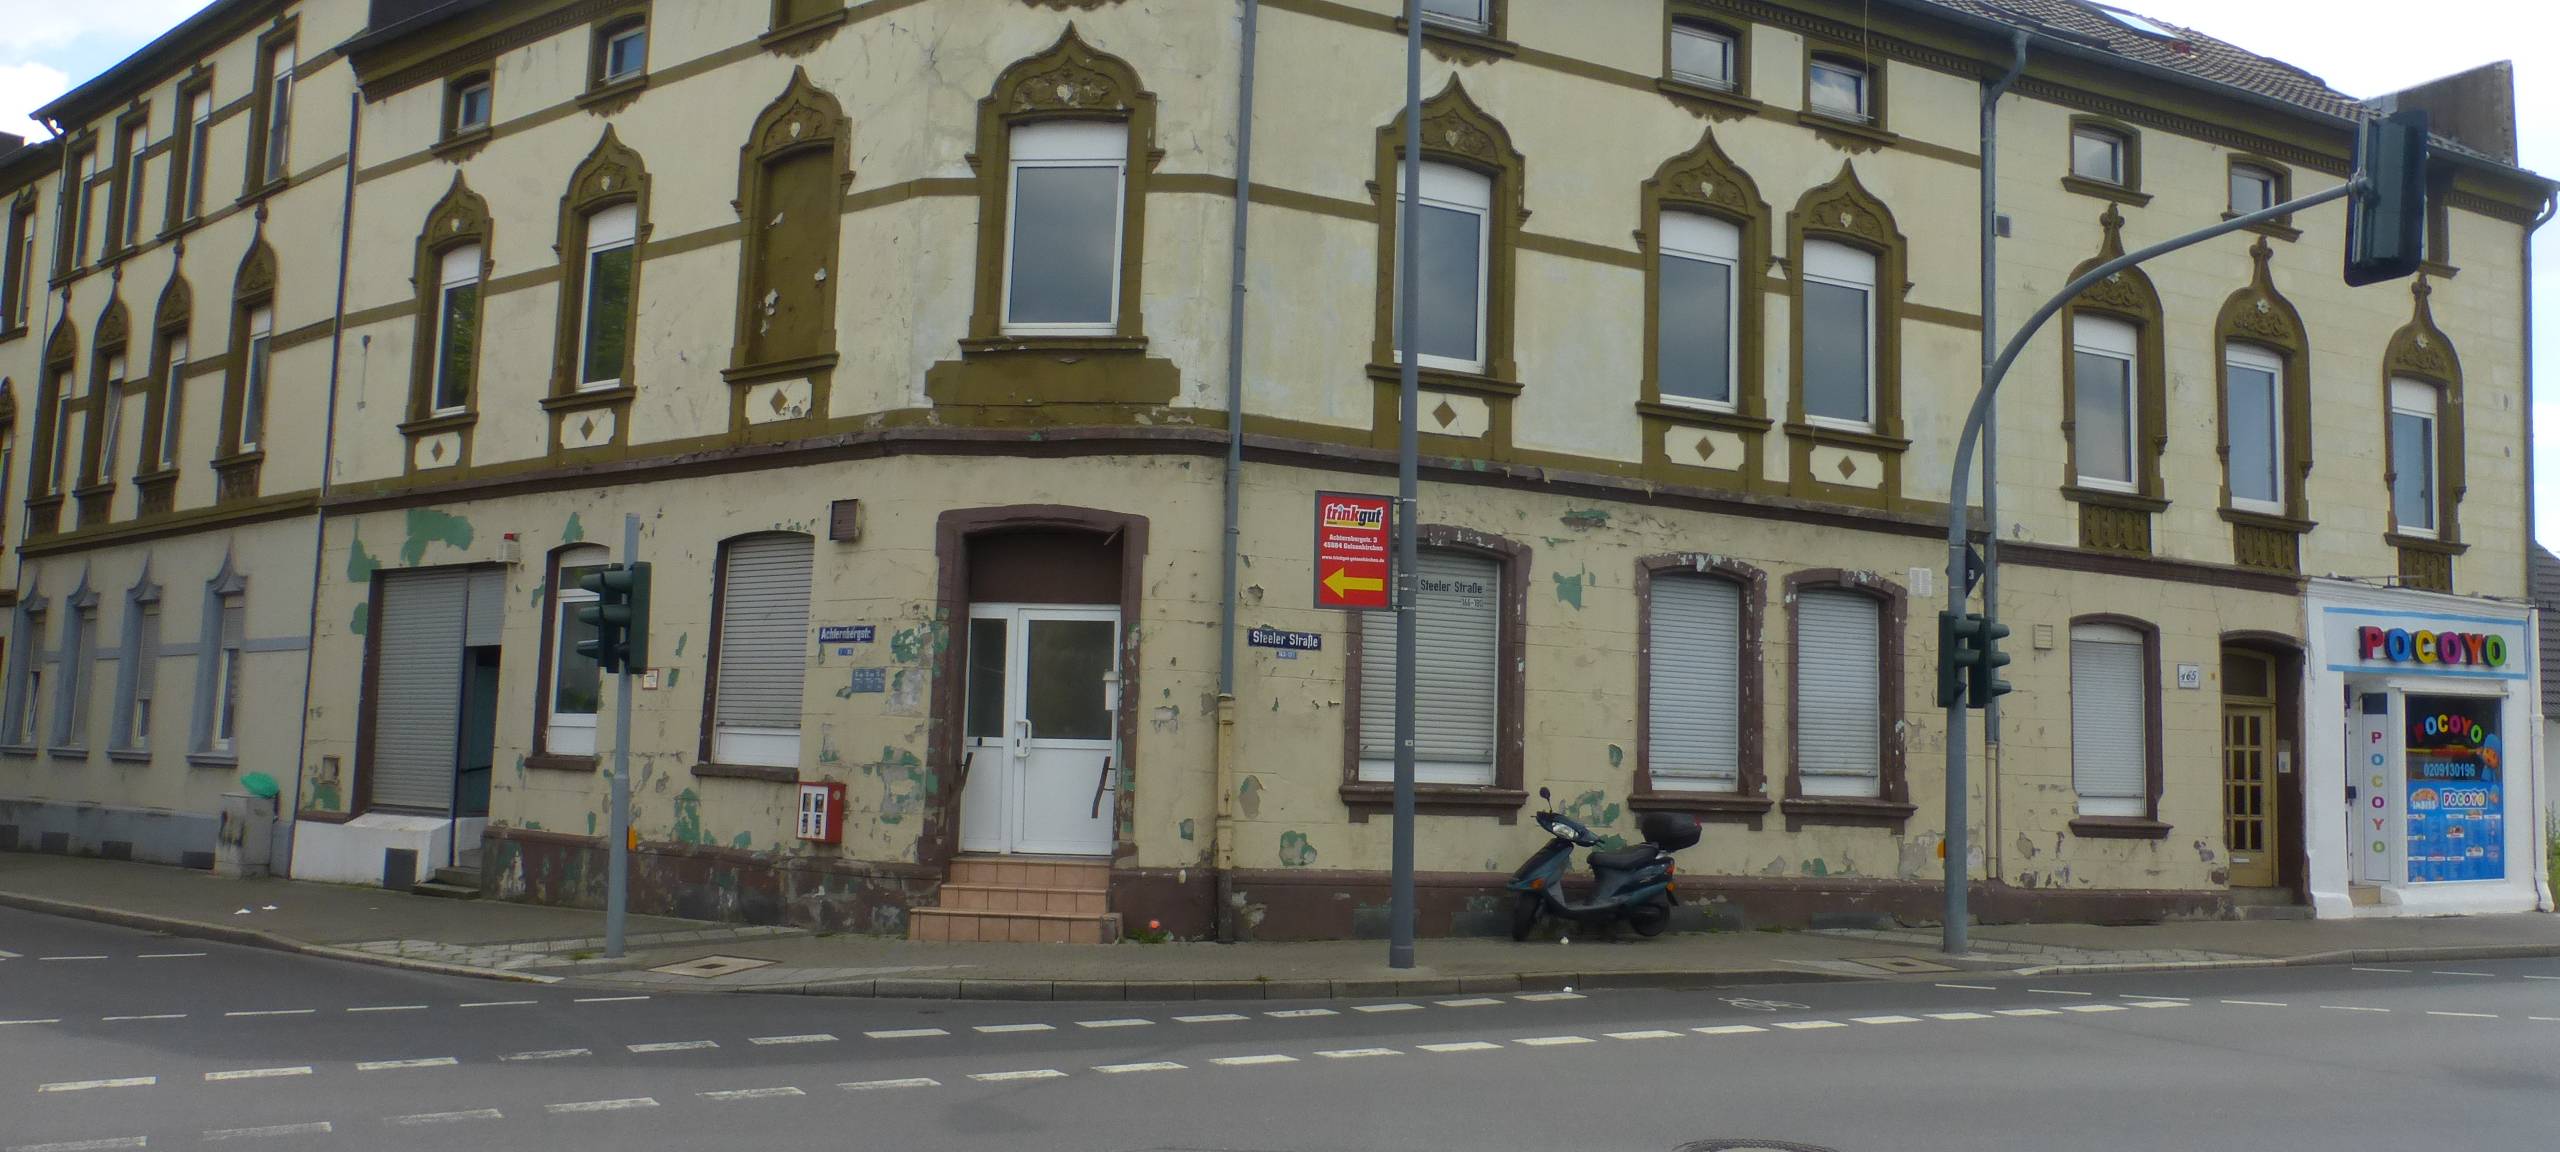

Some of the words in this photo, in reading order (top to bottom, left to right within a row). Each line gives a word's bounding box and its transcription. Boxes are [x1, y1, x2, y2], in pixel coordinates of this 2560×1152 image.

[1326, 504, 1383, 526] trinkgut
[1420, 579, 1451, 592] Steeler
[1454, 581, 1483, 594] Straße
[1253, 631, 1286, 645] Steeler
[1289, 633, 1318, 648] Straße
[2358, 626, 2507, 668] POCOYO
[2414, 714, 2482, 743] POCOYO
[2443, 791, 2486, 807] POCOYO
